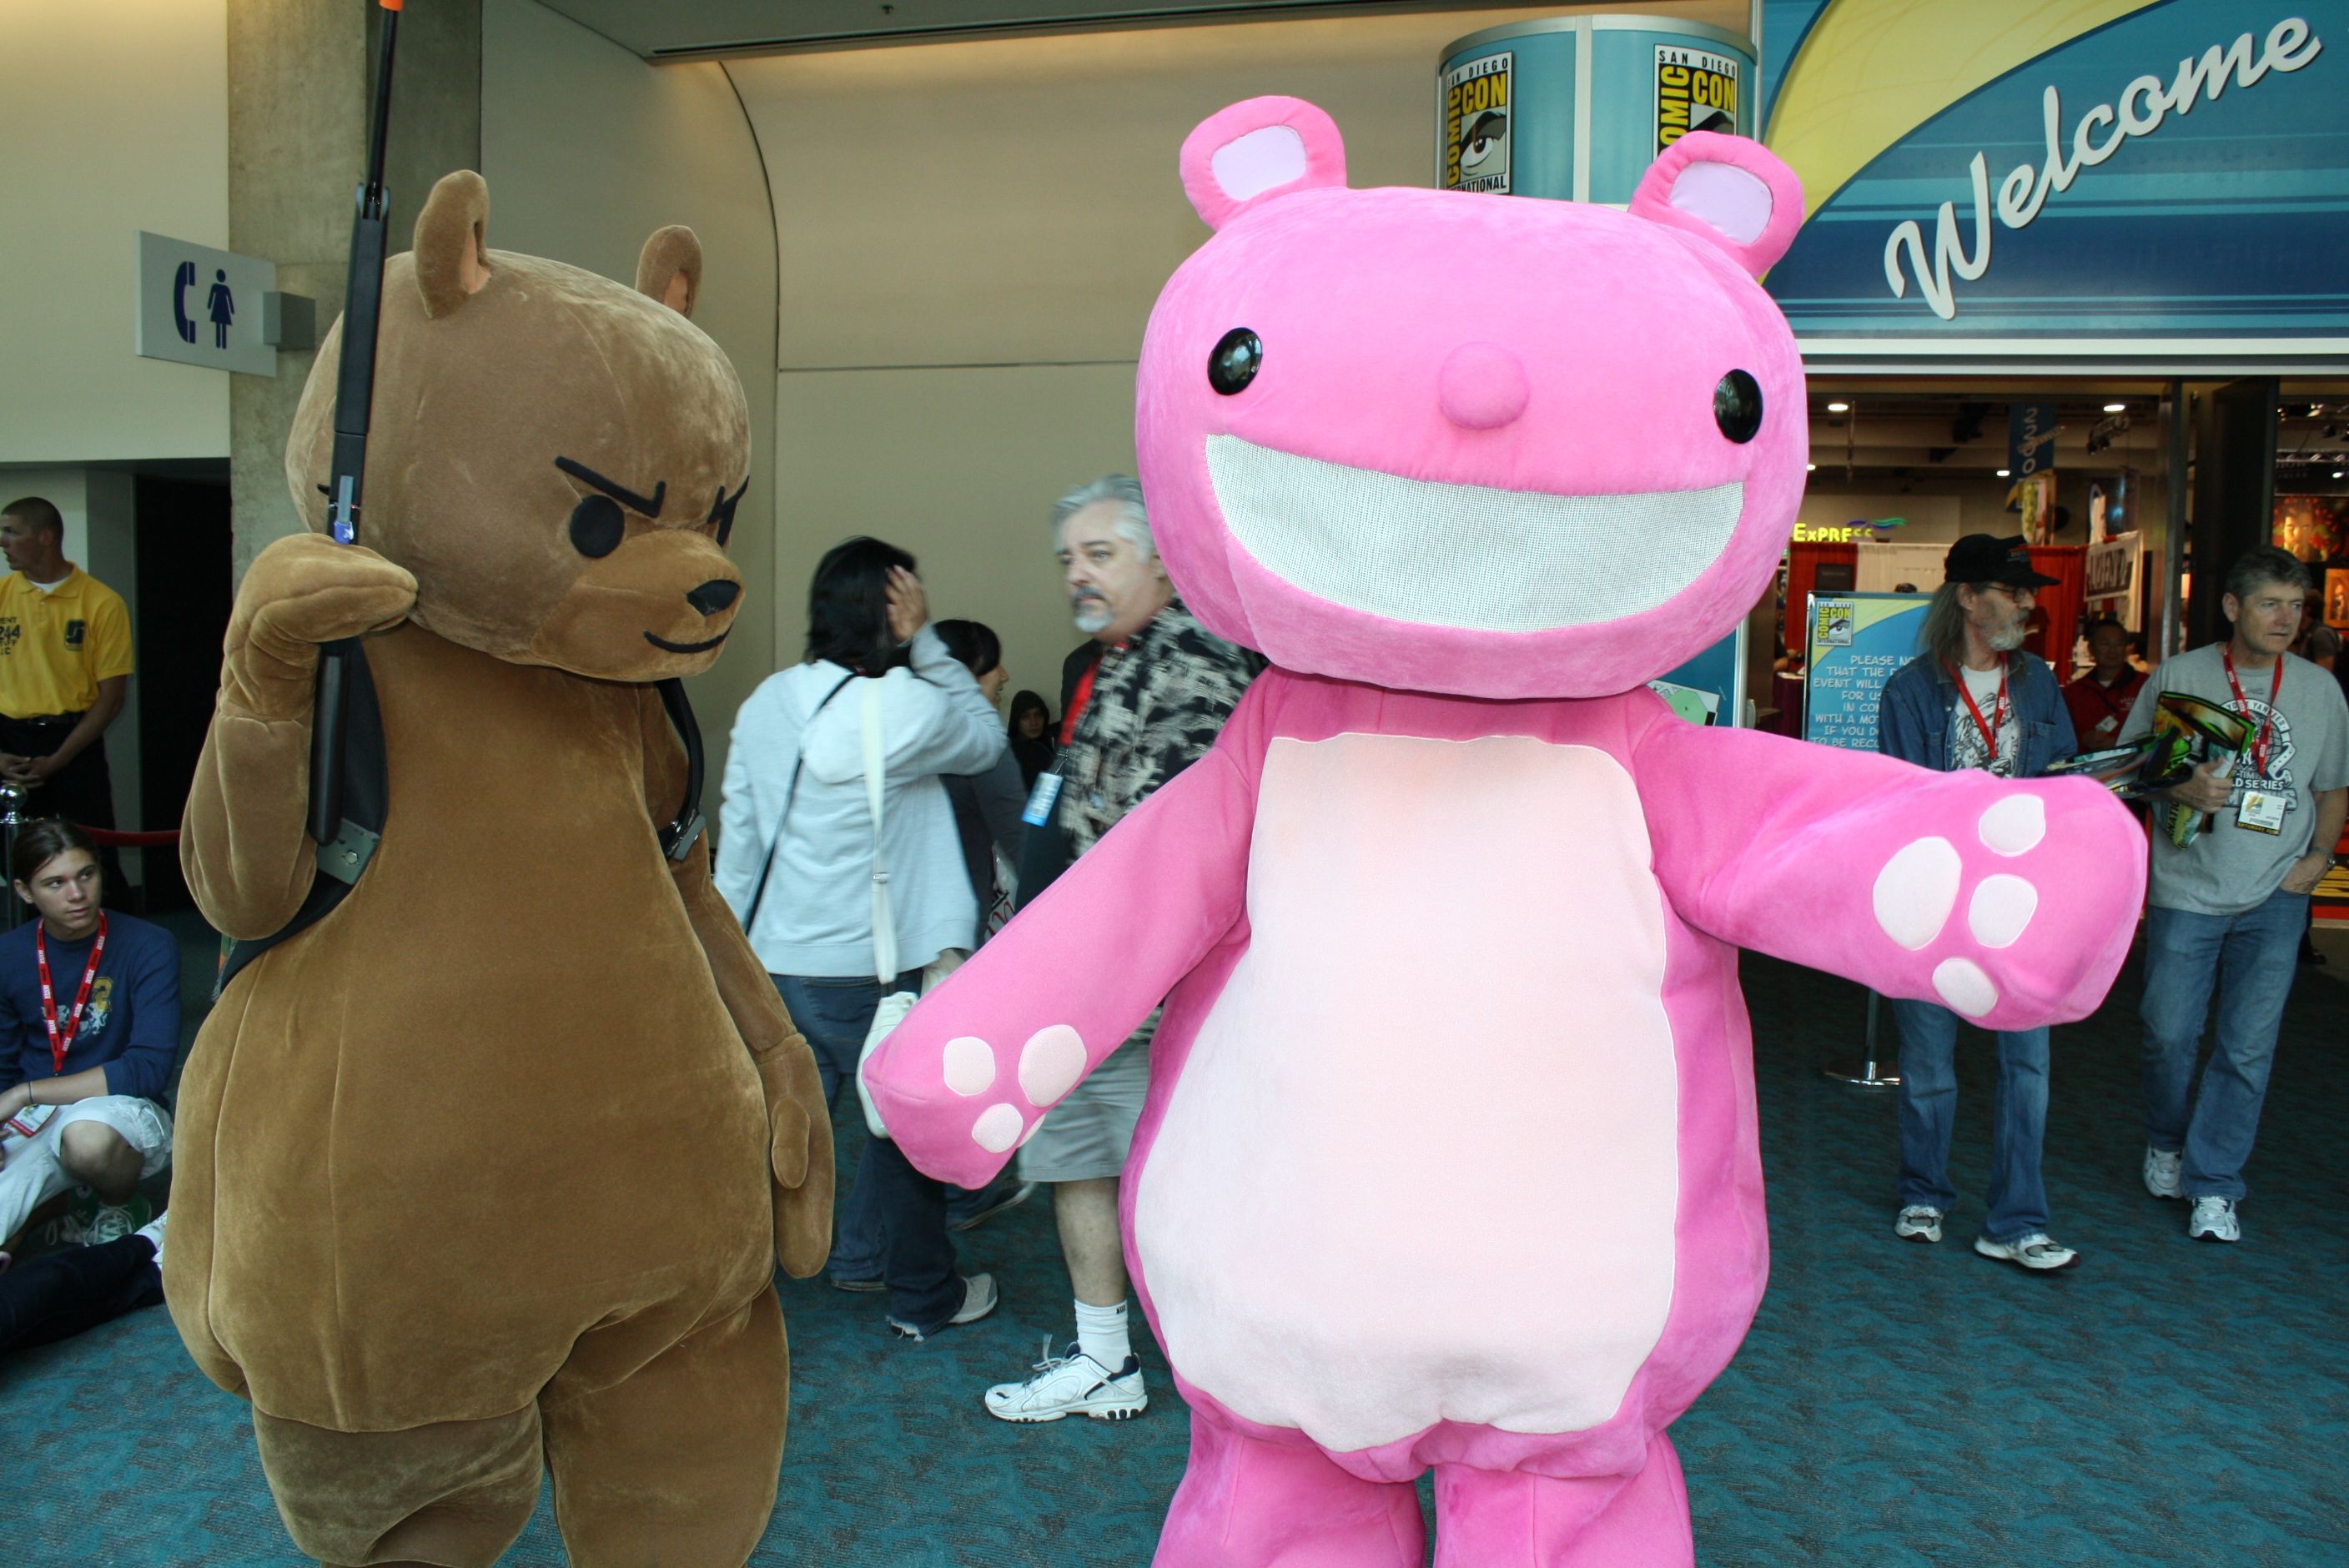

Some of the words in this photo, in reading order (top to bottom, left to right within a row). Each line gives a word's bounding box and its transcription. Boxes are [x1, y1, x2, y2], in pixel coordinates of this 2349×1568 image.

[1659, 50, 1688, 65] SAN
[1703, 57, 1736, 78] DIEGO
[1448, 74, 1461, 88] SAN
[1469, 58, 1508, 78] DIEGO
[1462, 73, 1507, 116] CON
[1693, 69, 1735, 113] CON
[1659, 66, 1689, 146] OMIC
[1447, 86, 1461, 186] COMIC
[1884, 18, 2321, 319] Welcome
[1830, 607, 1850, 618] CON
[1818, 607, 1829, 639] COMIC
[1850, 655, 1894, 666] PLEASE
[1827, 667, 1857, 676] THAT
[1861, 667, 1885, 677] THE
[1814, 678, 1852, 688] EVENT
[1857, 680, 1882, 689] WILL
[1842, 691, 1864, 701] FOR
[1843, 703, 1854, 711] IN
[1815, 714, 1843, 723] WITH
[1847, 715, 1855, 723] A
[1824, 726, 1837, 734] IF
[1842, 726, 1864, 736] YOU
[1812, 737, 1827, 746] TO
[1833, 738, 1847, 747] BE
[2245, 779, 2285, 791] SERIES
